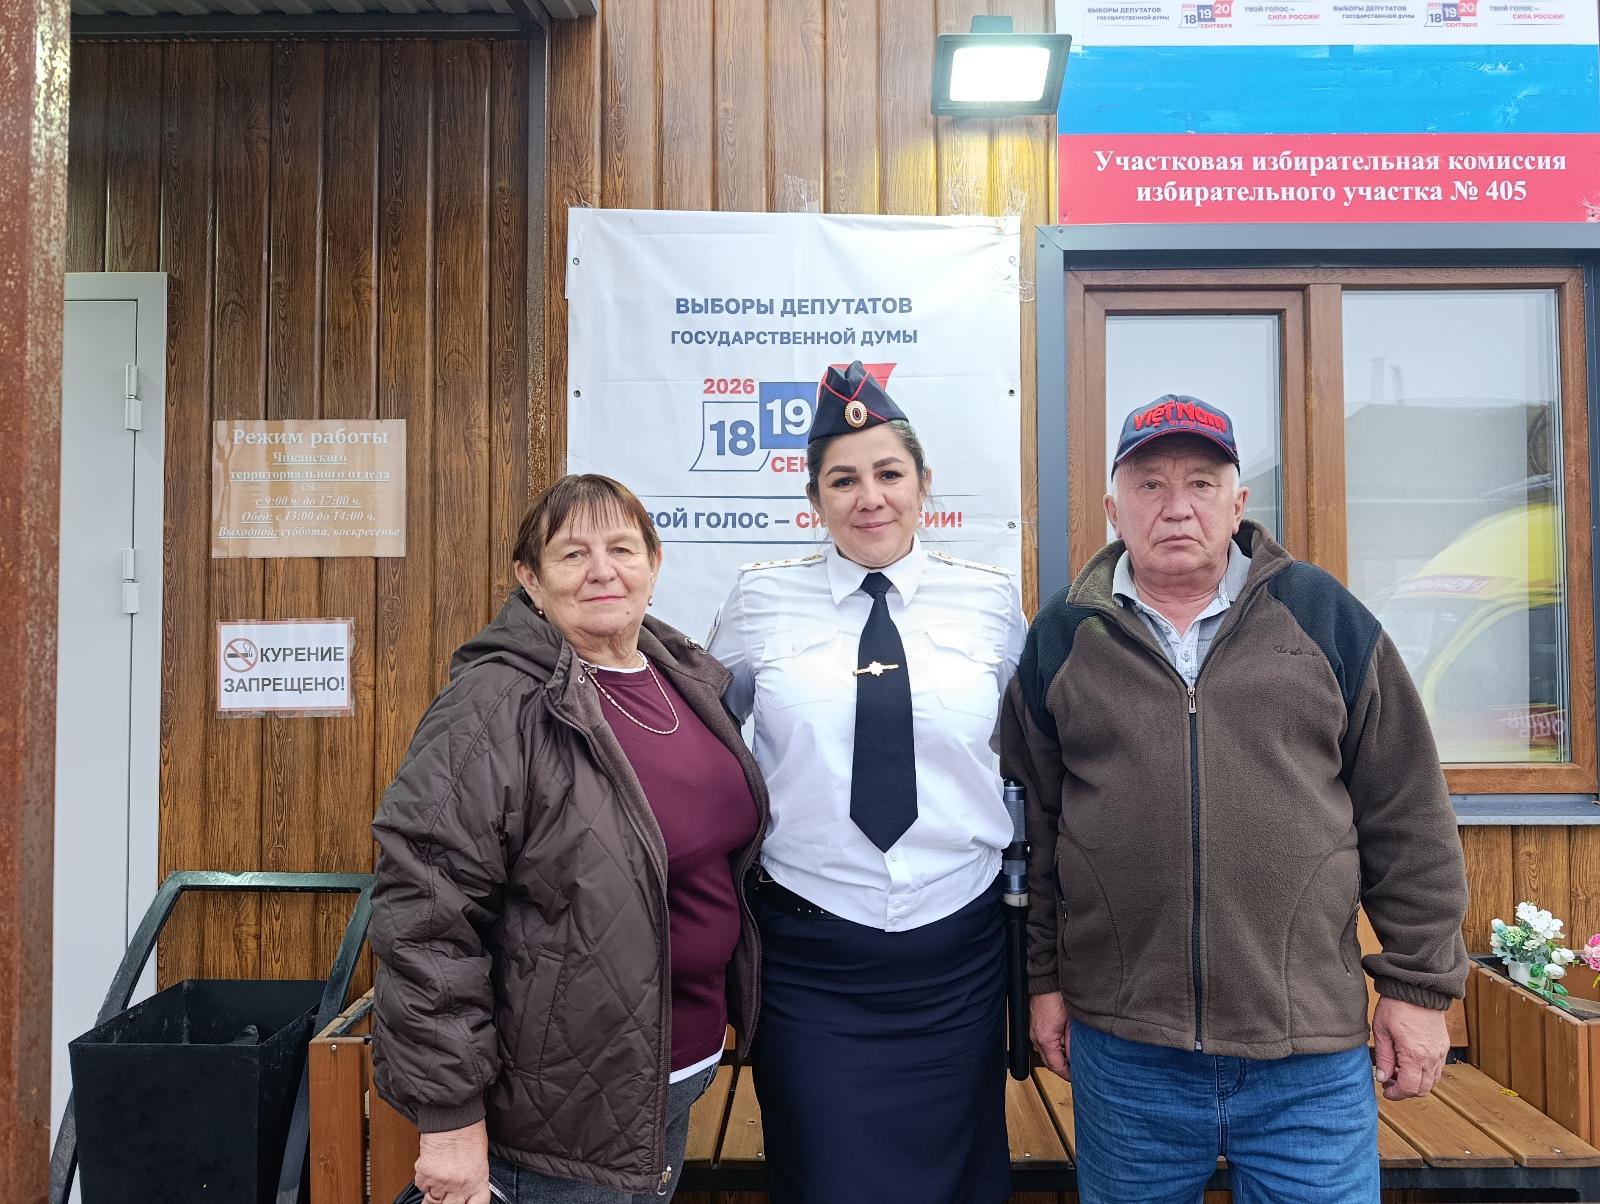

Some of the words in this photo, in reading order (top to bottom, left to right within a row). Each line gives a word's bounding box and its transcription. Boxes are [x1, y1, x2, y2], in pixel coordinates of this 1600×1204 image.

[1199, 9, 1212, 19] 19
[1214, 4, 1231, 14] 20
[1444, 7, 1457, 18] 19
[1459, 2, 1475, 13] 20
[1184, 14, 1197, 24] 18
[1429, 13, 1442, 23] 18
[1094, 150, 1244, 175] Участковая
[1252, 151, 1440, 175] избирательная
[1448, 154, 1567, 171] комиссия
[1136, 180, 1335, 207] избирательного
[1342, 184, 1443, 206] участка
[1450, 180, 1479, 202] №
[1485, 180, 1527, 201] 405
[676, 298, 775, 315] ВЫБОРЫ
[780, 298, 913, 318] ДЕПУТАТОВ
[671, 327, 856, 347] ГОСУДАРСТВЕННОЙ
[861, 330, 918, 347] ДУМЫ
[703, 378, 755, 395] 2026
[766, 398, 812, 436] 19
[233, 428, 304, 444] Режим
[311, 426, 389, 448] работы
[709, 420, 756, 456] 18
[230, 471, 344, 482] территориального
[348, 471, 391, 481] отдела
[264, 496, 288, 506] 9:00
[303, 496, 316, 506] до
[319, 496, 349, 506] 17:00
[352, 498, 362, 506] ч.
[241, 511, 273, 522] Обед:
[285, 511, 314, 521] 13:00
[317, 511, 330, 521] до
[333, 511, 363, 521] 14:00
[367, 512, 376, 521] ч.
[694, 511, 769, 528] ГОЛОС
[218, 526, 278, 538] Выходной:
[281, 527, 330, 538] суббота,
[333, 528, 400, 538] воскресенье
[260, 647, 345, 662] КУРЕНИЕ
[223, 676, 345, 695] ЗАПРЕЩЕНО!
